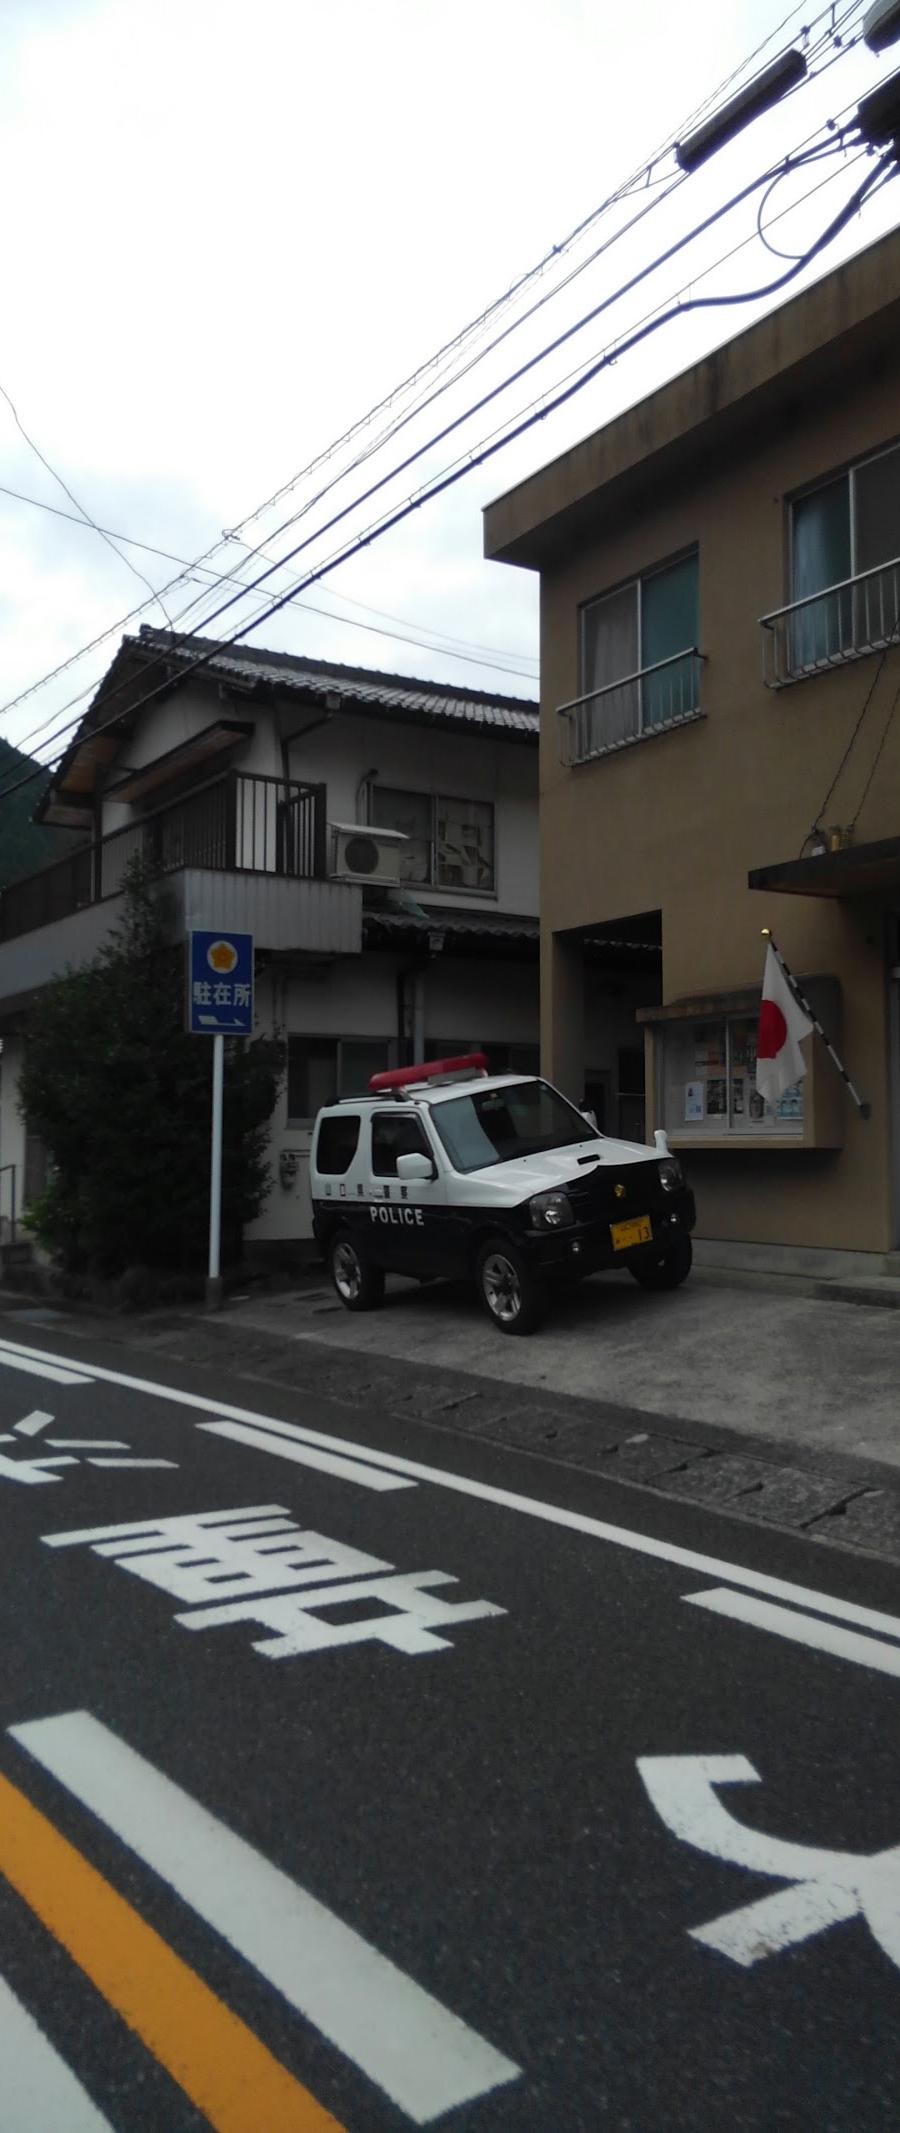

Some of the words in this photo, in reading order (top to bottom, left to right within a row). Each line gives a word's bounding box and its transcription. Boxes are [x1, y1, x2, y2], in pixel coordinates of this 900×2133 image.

[193, 981, 251, 1008] 駐在所
[370, 1206, 425, 1226] POLICE
